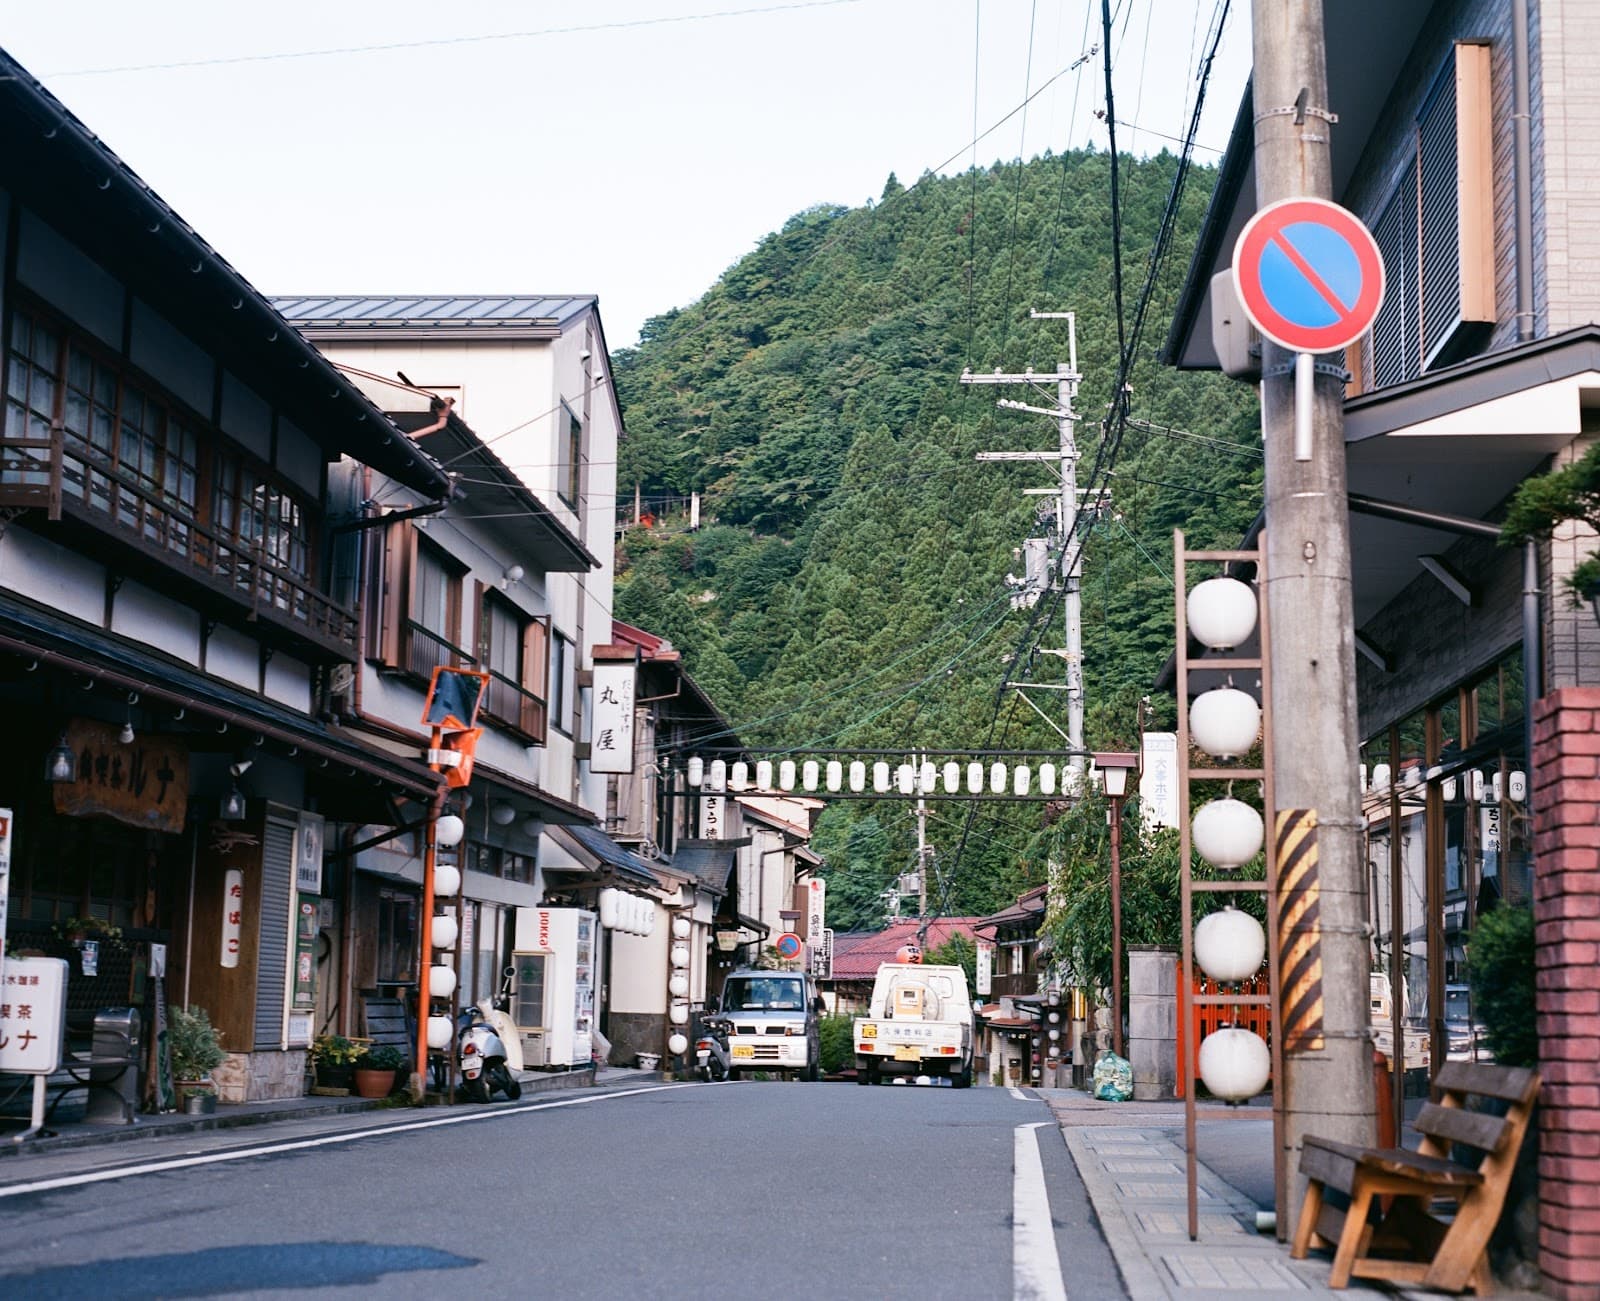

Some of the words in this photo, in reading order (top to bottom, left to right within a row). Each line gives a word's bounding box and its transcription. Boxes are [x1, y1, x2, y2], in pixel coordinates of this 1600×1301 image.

[597, 685, 618, 751] 丸屋
[228, 884, 241, 953] たばこ
